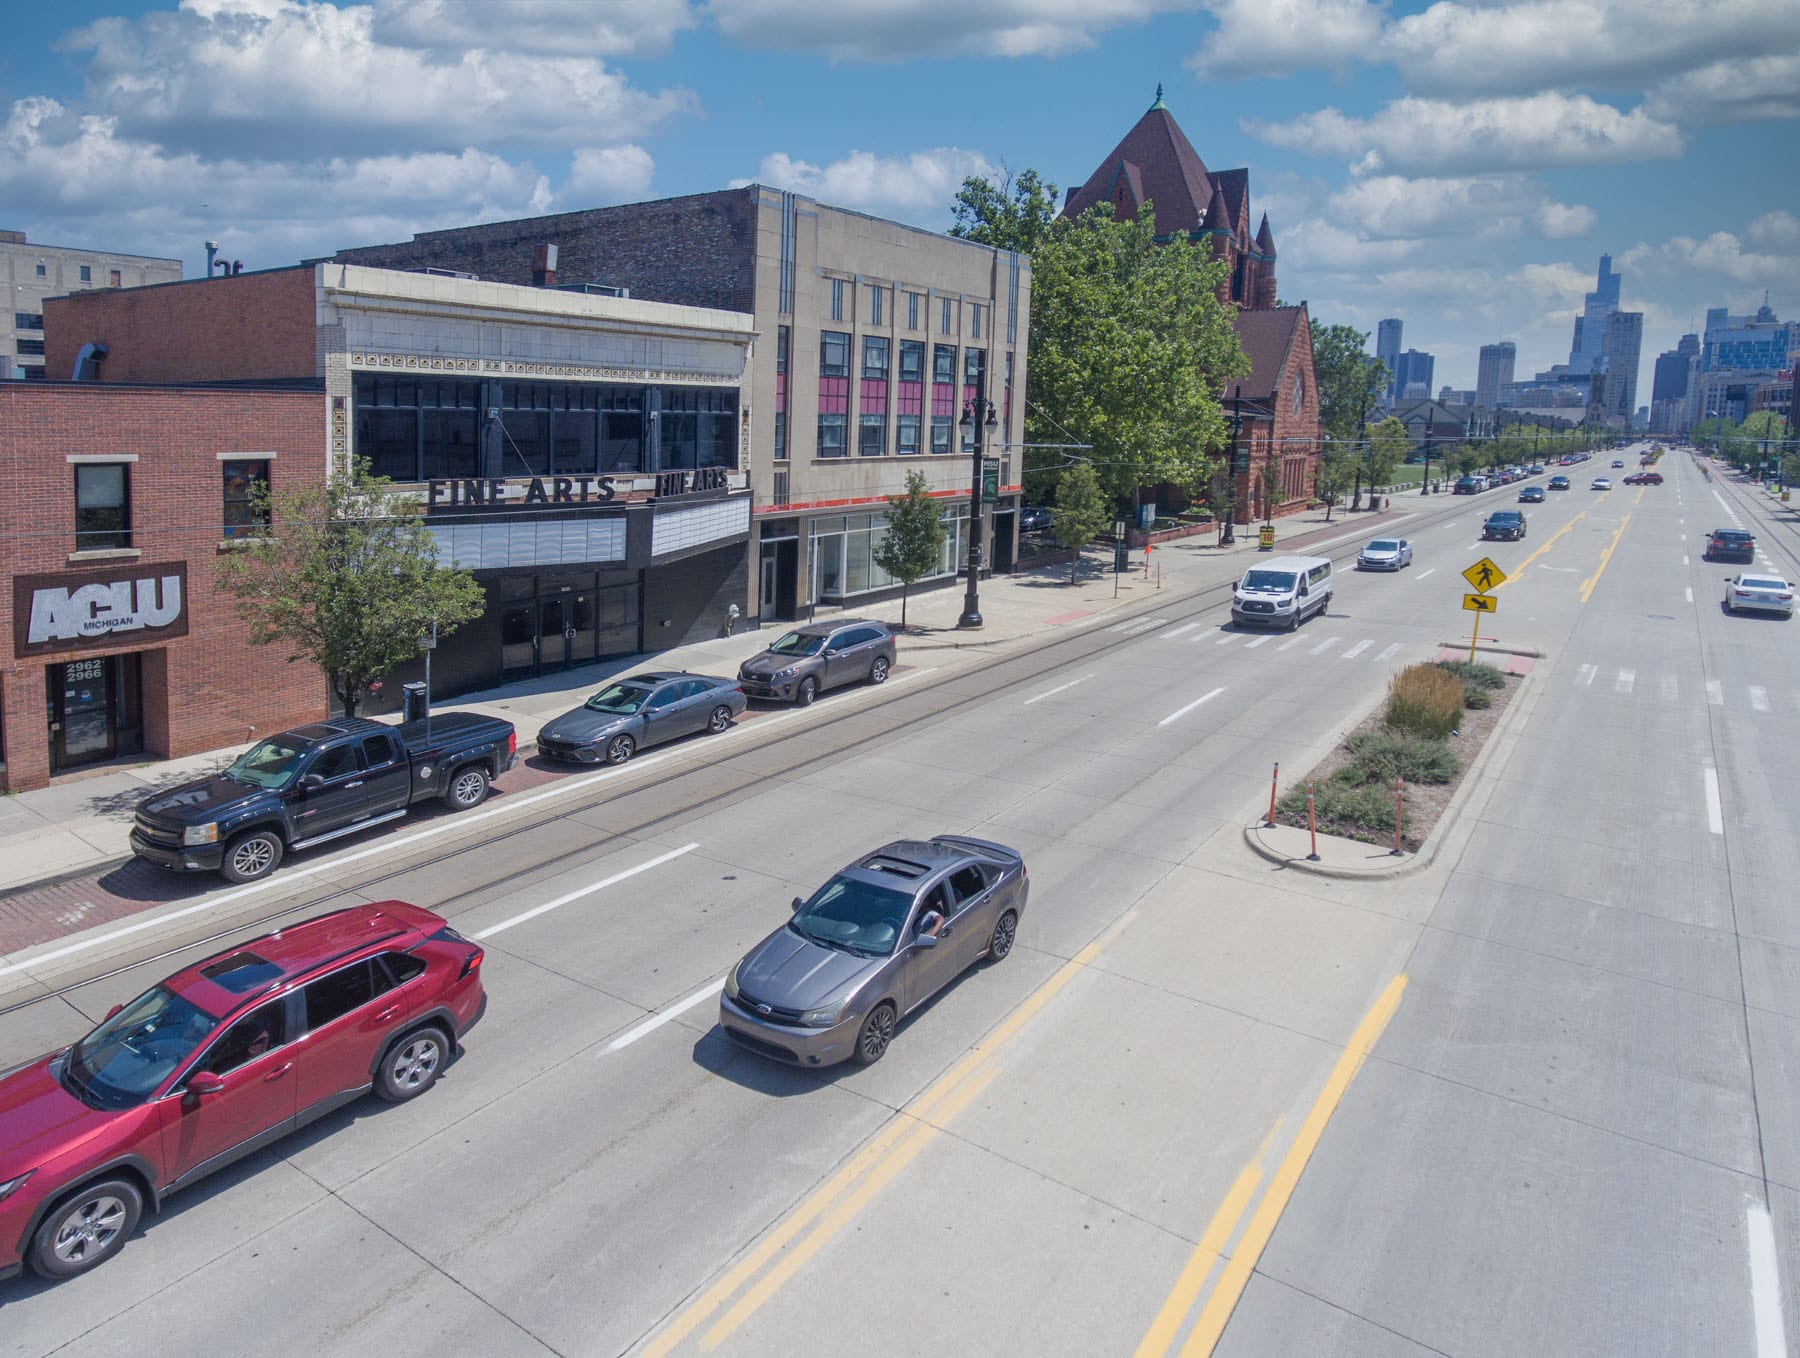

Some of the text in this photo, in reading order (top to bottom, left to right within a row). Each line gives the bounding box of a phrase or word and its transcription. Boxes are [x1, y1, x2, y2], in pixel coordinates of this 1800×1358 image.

[429, 476, 616, 506] FINE ARTS
[656, 467, 728, 497] FINE ARTS
[28, 575, 181, 644] ACLU
[83, 617, 134, 631] MICHIGAN
[66, 660, 102, 673] 2962
[66, 669, 102, 682] 2966
